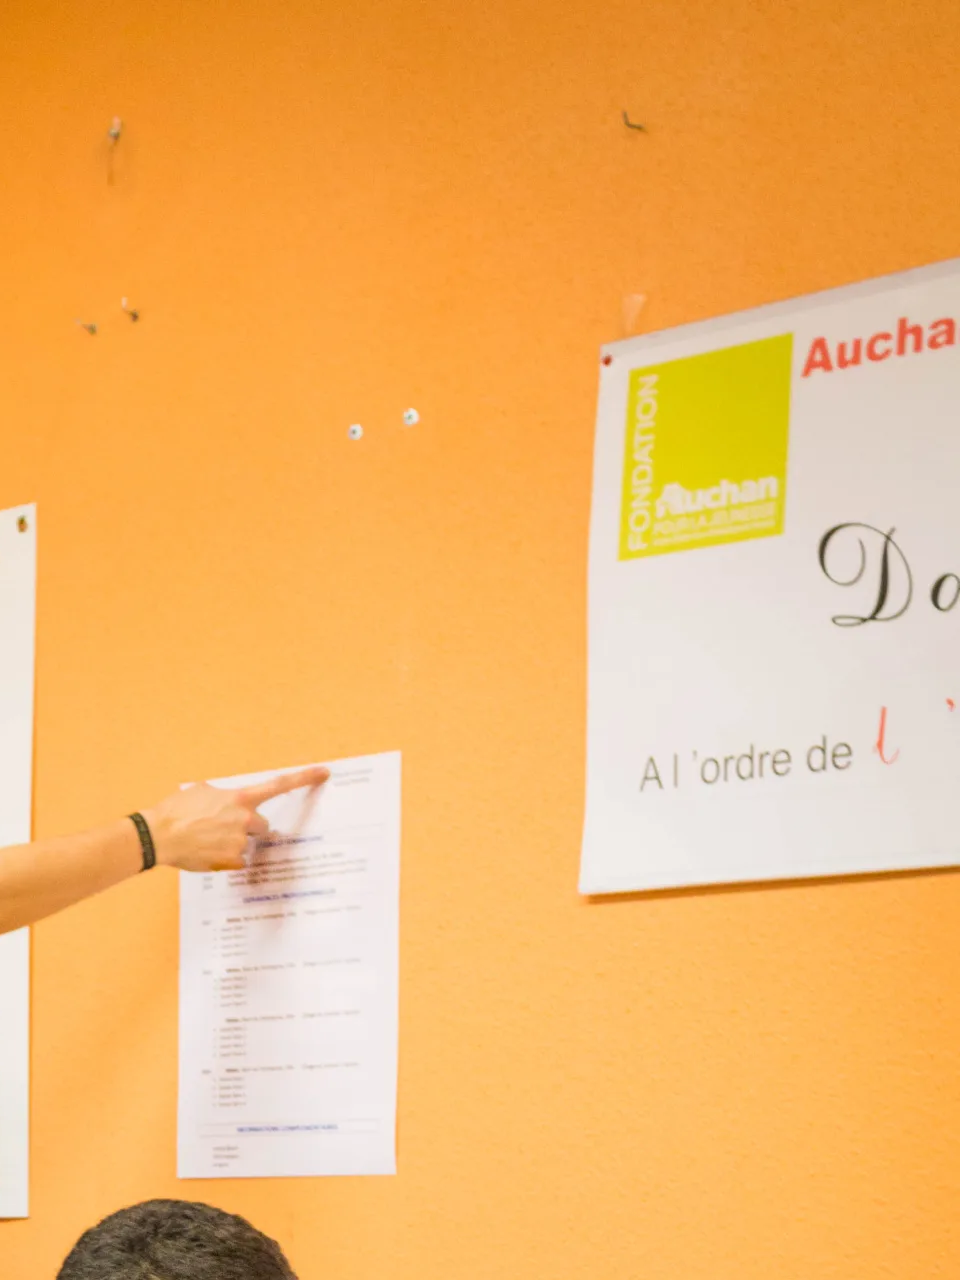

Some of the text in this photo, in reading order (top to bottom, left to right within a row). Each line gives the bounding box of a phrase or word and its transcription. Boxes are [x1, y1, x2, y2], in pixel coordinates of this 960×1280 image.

[800, 316, 960, 378] Aucha
[628, 374, 659, 552] FONDATION
[655, 476, 778, 518] Auchan
[818, 522, 960, 627] Do
[639, 756, 664, 792] A
[806, 735, 854, 773] de
